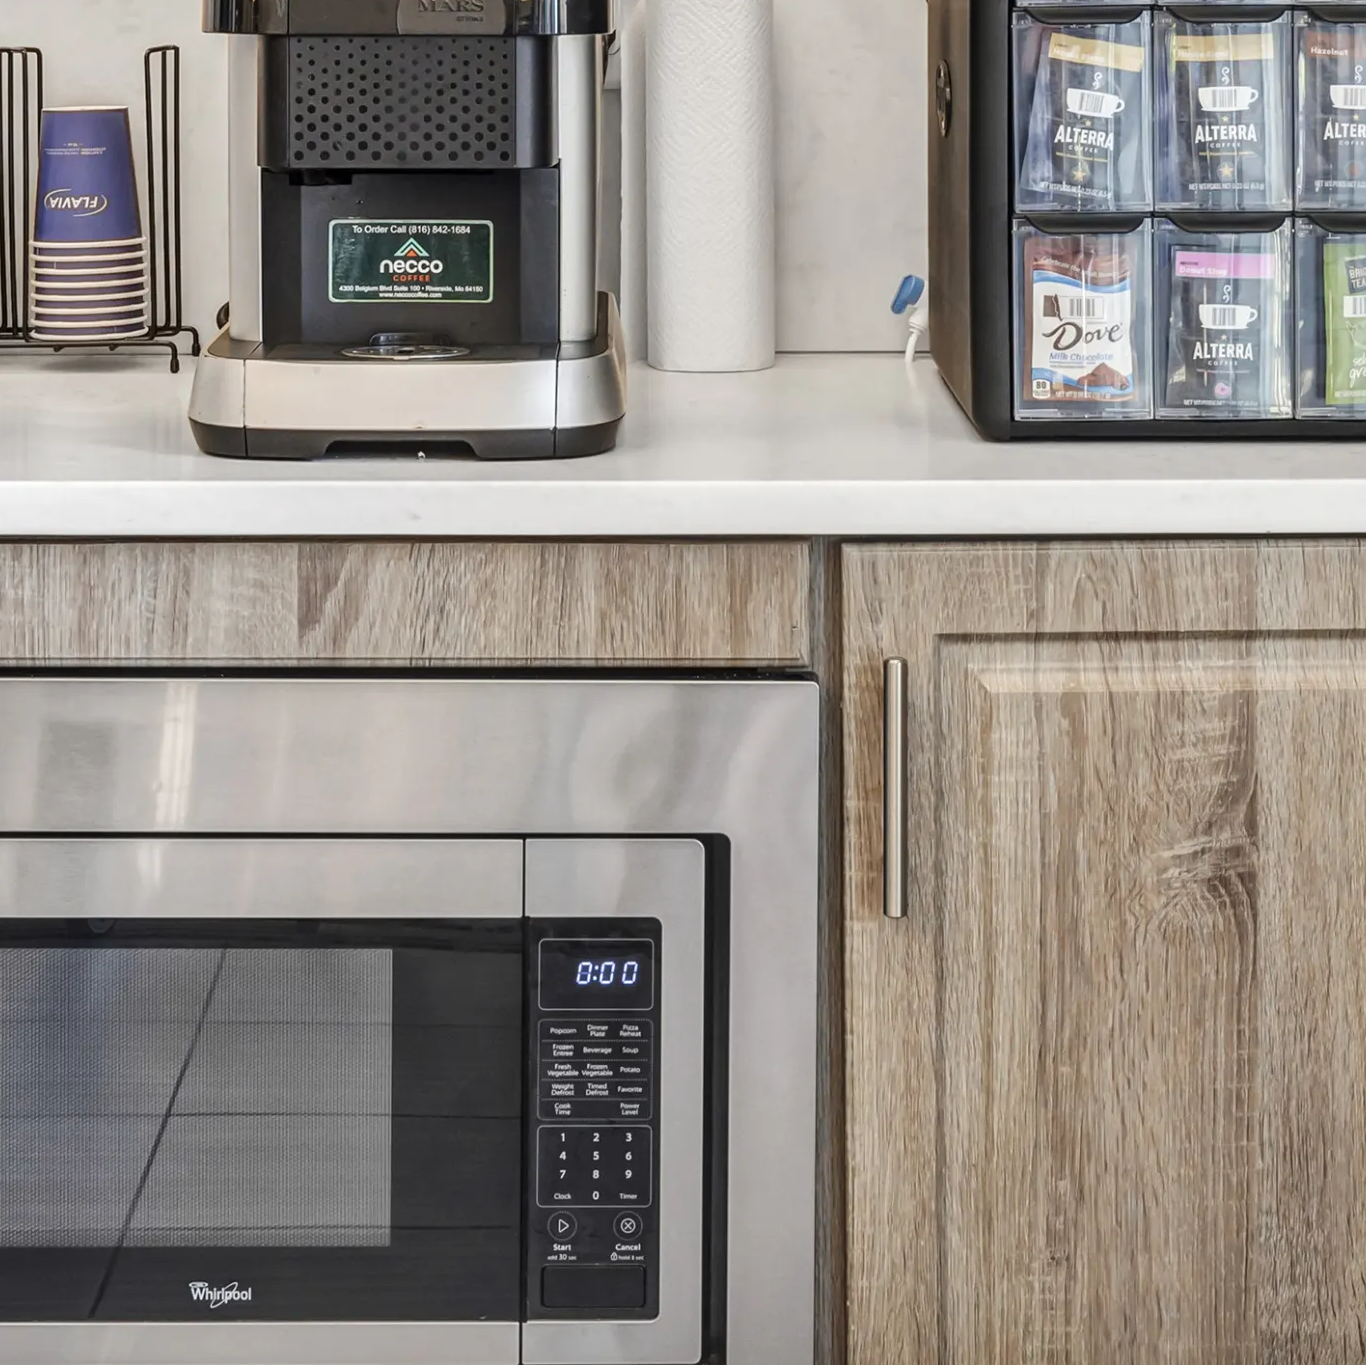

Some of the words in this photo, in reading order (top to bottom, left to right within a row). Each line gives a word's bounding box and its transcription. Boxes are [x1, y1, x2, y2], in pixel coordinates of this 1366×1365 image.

[1311, 47, 1348, 56] Hazelnut
[1054, 124, 1114, 151] ALTERRA
[1195, 123, 1258, 144] ALTERRA
[49, 196, 97, 209] FLAVIA
[352, 225, 362, 233] To
[364, 225, 388, 234] Order
[390, 225, 406, 234] Call
[408, 226, 430, 234] (816)
[432, 226, 471, 234] 842-1684
[379, 259, 443, 273] necco
[1351, 278, 1366, 289] TEA
[1042, 322, 1123, 351] Dove
[1193, 341, 1253, 360] ALTERRA
[1036, 381, 1047, 389] 80
[561, 1133, 565, 1142] 1
[593, 1133, 599, 1142] 2
[625, 1133, 632, 1142] 3
[559, 1151, 566, 1160] 4
[593, 1151, 599, 1160] 5
[625, 1151, 632, 1160] 6
[559, 1170, 566, 1179] 7
[593, 1170, 599, 1179] 8
[625, 1170, 632, 1179] 9
[593, 1191, 599, 1200] 0
[615, 1243, 641, 1251] Cancel
[190, 1285, 251, 1305] Whirlpool
